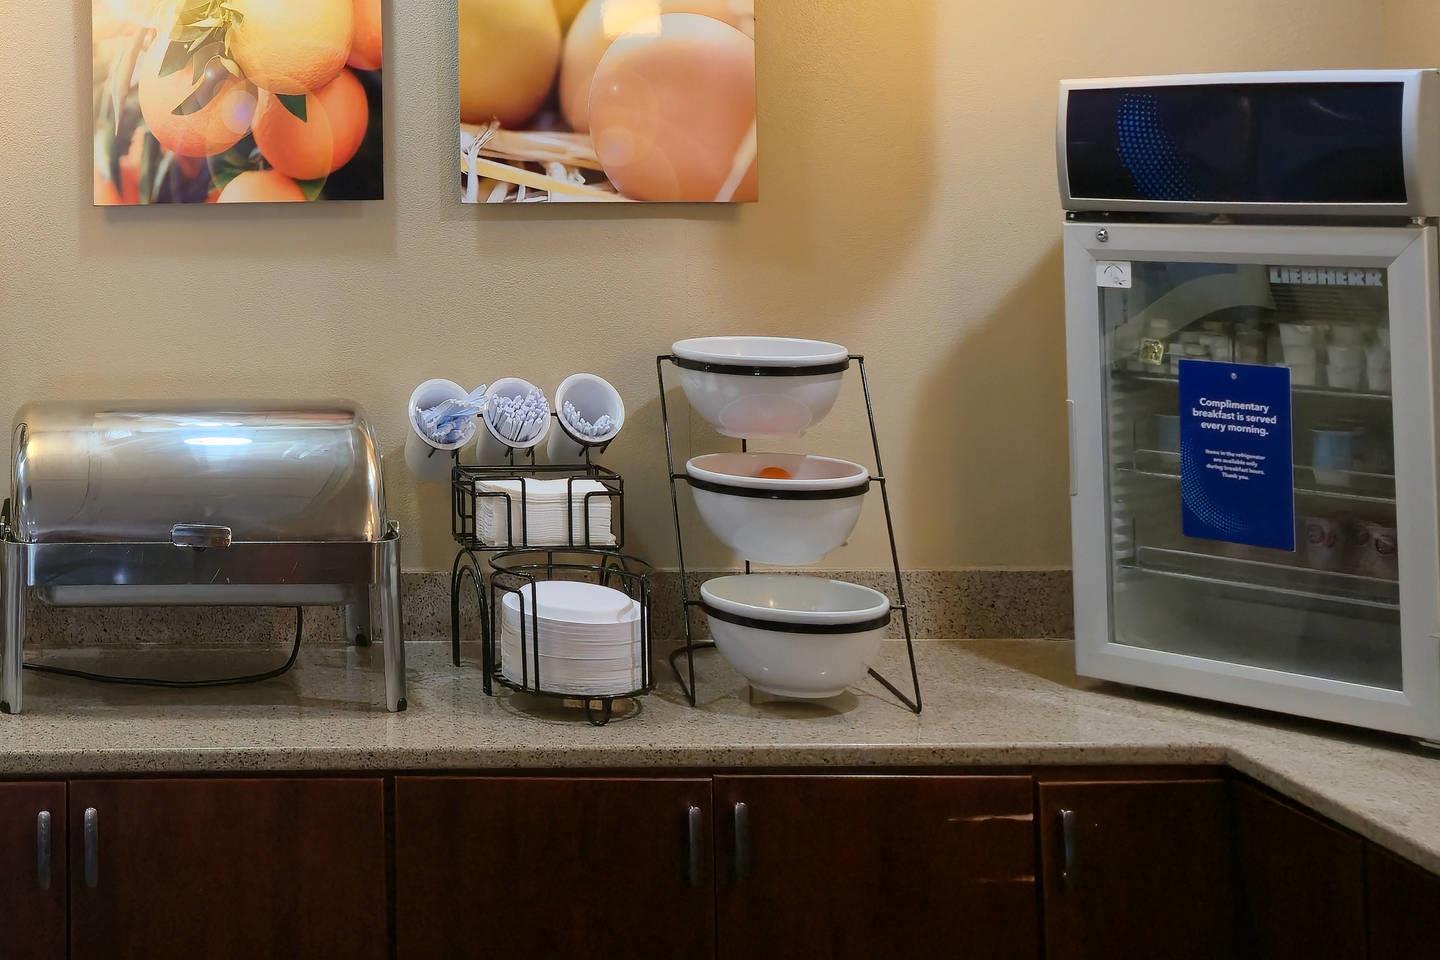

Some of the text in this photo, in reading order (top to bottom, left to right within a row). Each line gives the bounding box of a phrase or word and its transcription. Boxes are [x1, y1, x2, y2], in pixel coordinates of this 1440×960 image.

[1269, 266, 1383, 286] LIEBHERR
[1199, 397, 1270, 414] Complimentary
[1192, 407, 1277, 425] breakfast is served
[1200, 421, 1269, 437] every morning.
